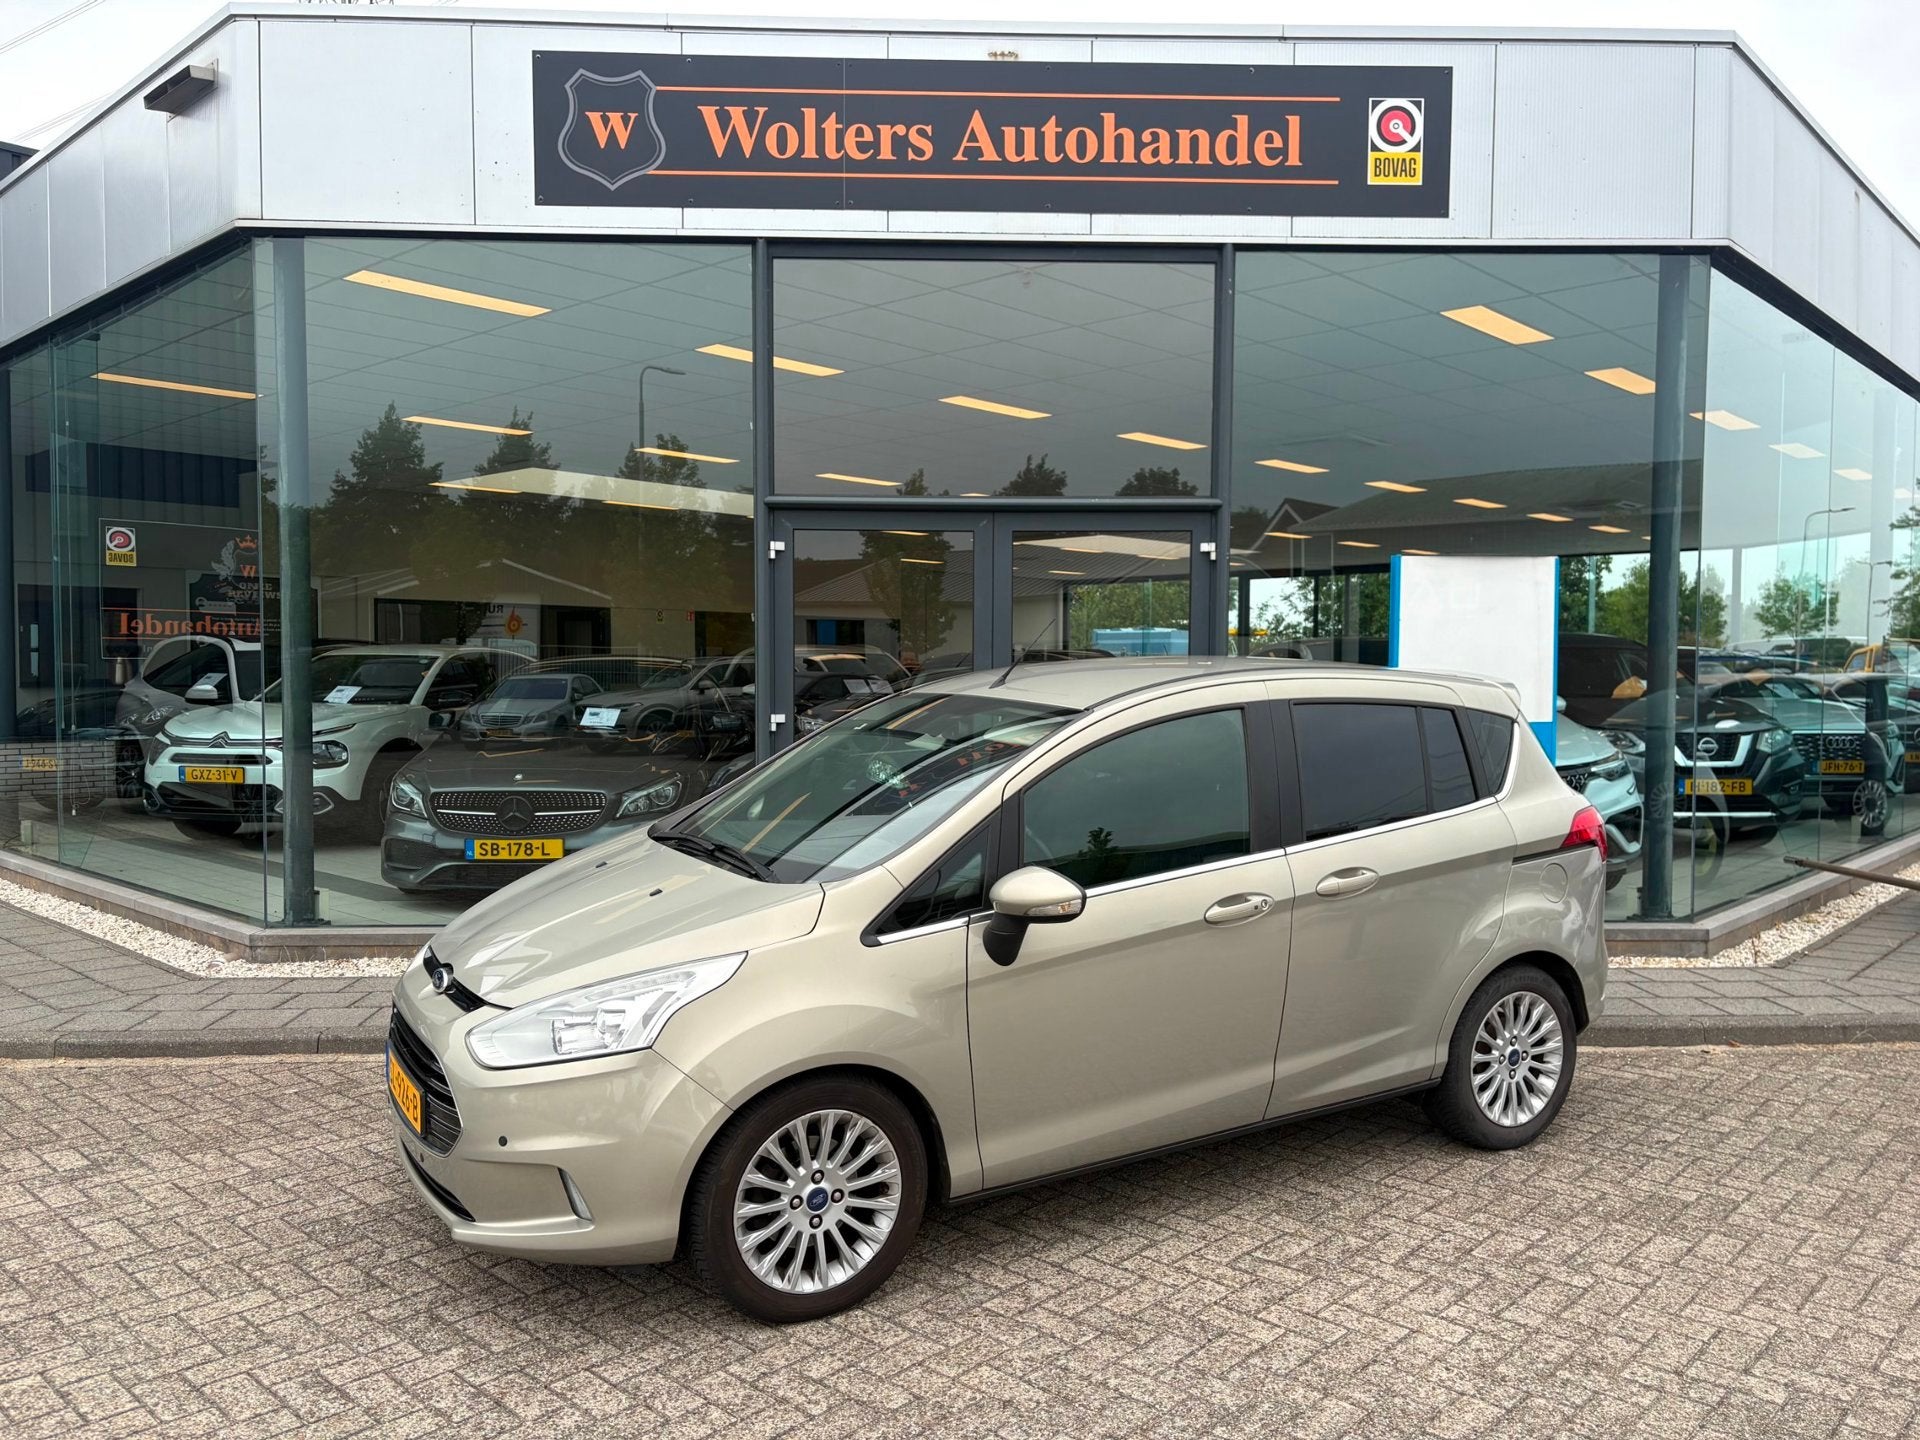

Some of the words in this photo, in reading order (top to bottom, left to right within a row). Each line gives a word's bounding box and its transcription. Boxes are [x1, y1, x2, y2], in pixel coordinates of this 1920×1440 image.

[585, 111, 639, 150] W
[697, 105, 935, 161] Wolters
[952, 109, 1303, 167] Autohandel
[1374, 157, 1417, 179] BOVAG
[191, 769, 237, 781] GXZ-31-V
[479, 842, 550, 857] SB-178-L
